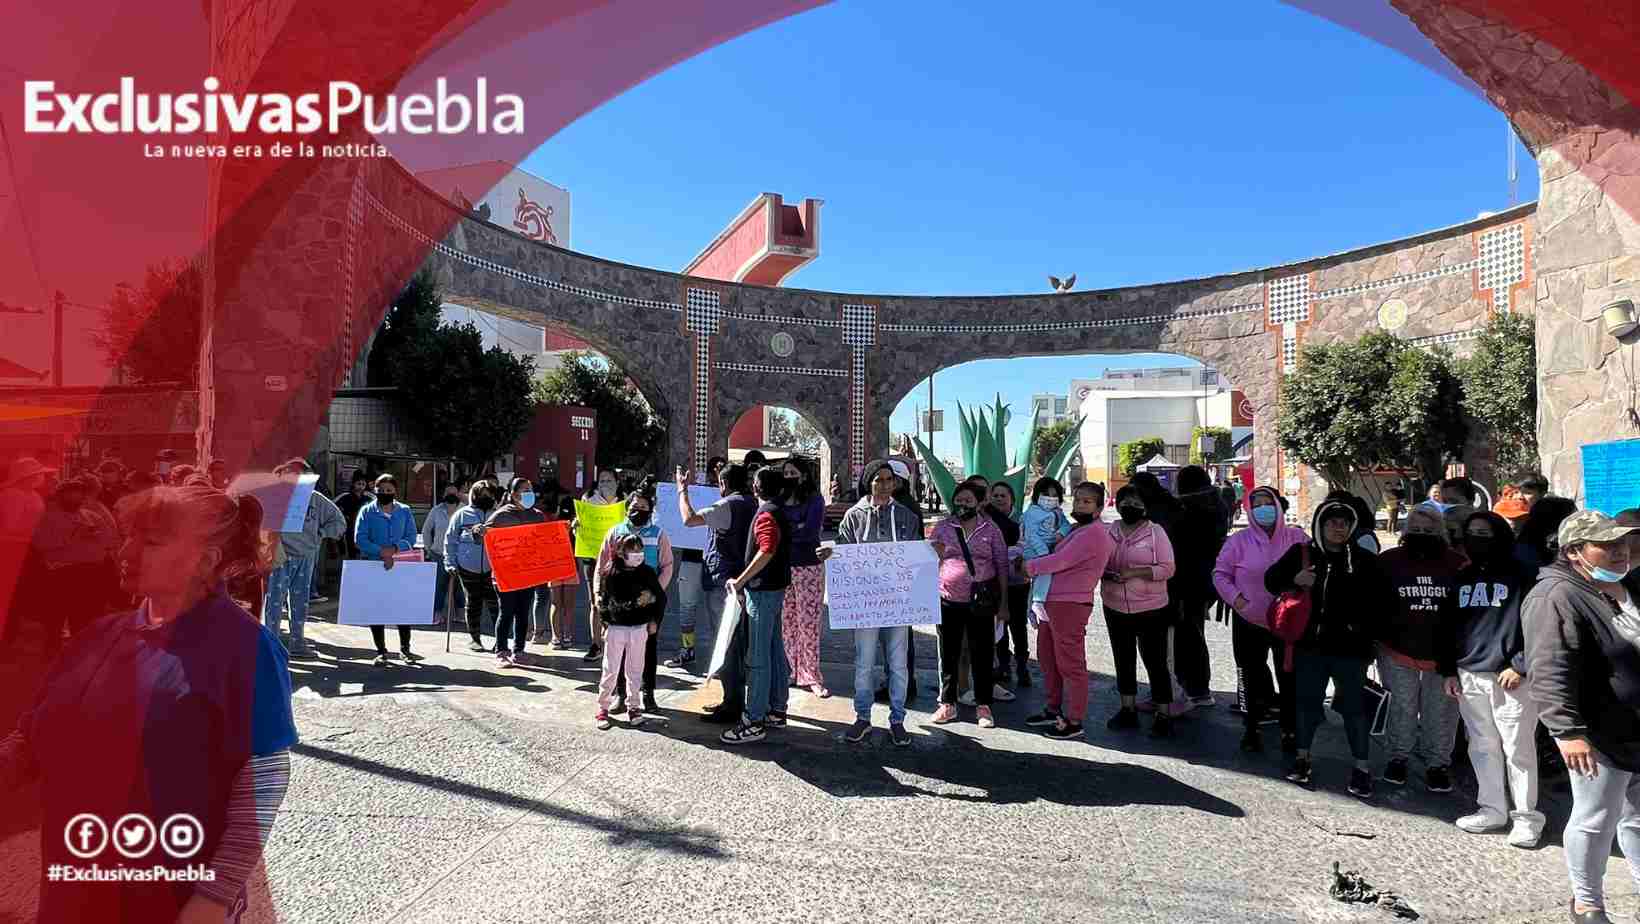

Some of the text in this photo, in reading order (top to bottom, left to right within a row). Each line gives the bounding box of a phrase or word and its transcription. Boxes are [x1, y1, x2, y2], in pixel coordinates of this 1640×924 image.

[1416, 576, 1432, 585] THE
[1398, 586, 1451, 598] STRUGGL
[1459, 582, 1508, 608] GAP
